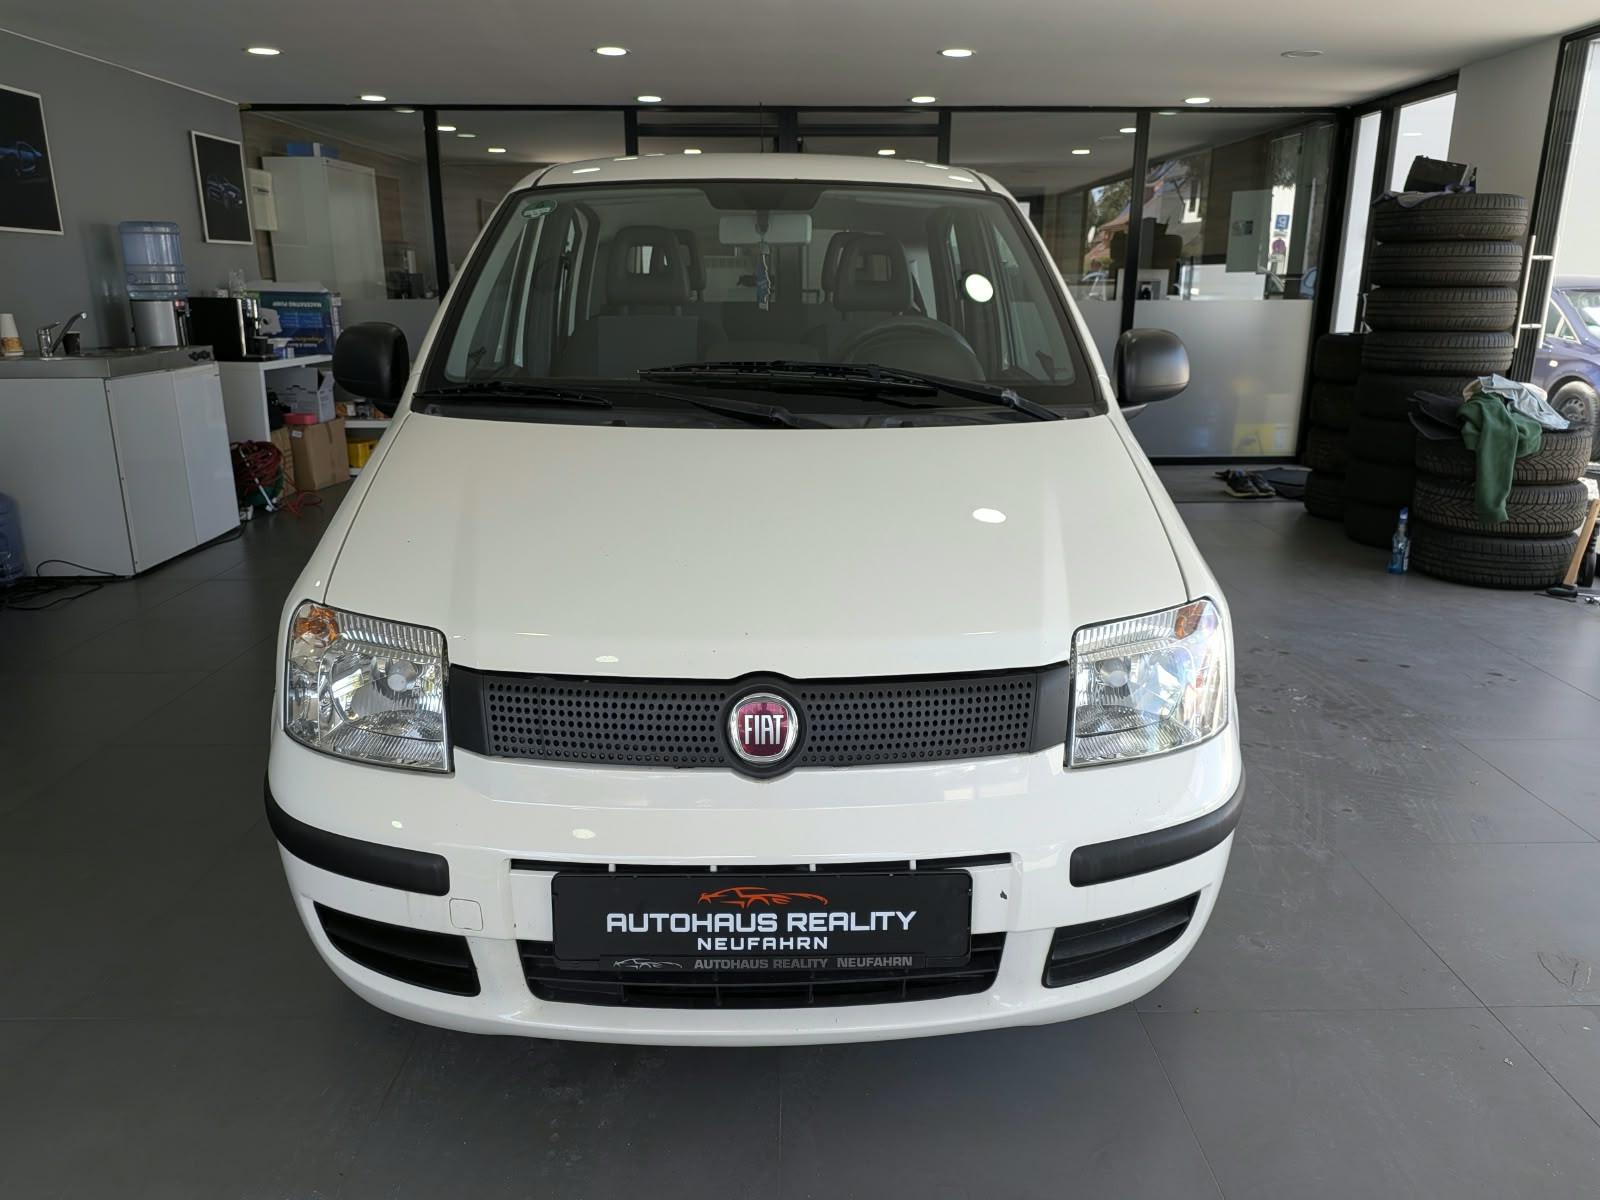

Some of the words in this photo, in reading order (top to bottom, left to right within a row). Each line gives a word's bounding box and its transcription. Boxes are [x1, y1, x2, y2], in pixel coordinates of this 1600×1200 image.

[744, 714, 784, 745] FIAT
[606, 912, 778, 933] AUTOHAUS
[787, 910, 917, 932] REALITY
[697, 936, 828, 951] NEUFAHRN
[694, 959, 769, 969] AUTOHAUS
[772, 958, 828, 969] REALITY
[836, 956, 913, 968] NEUFAHRN
